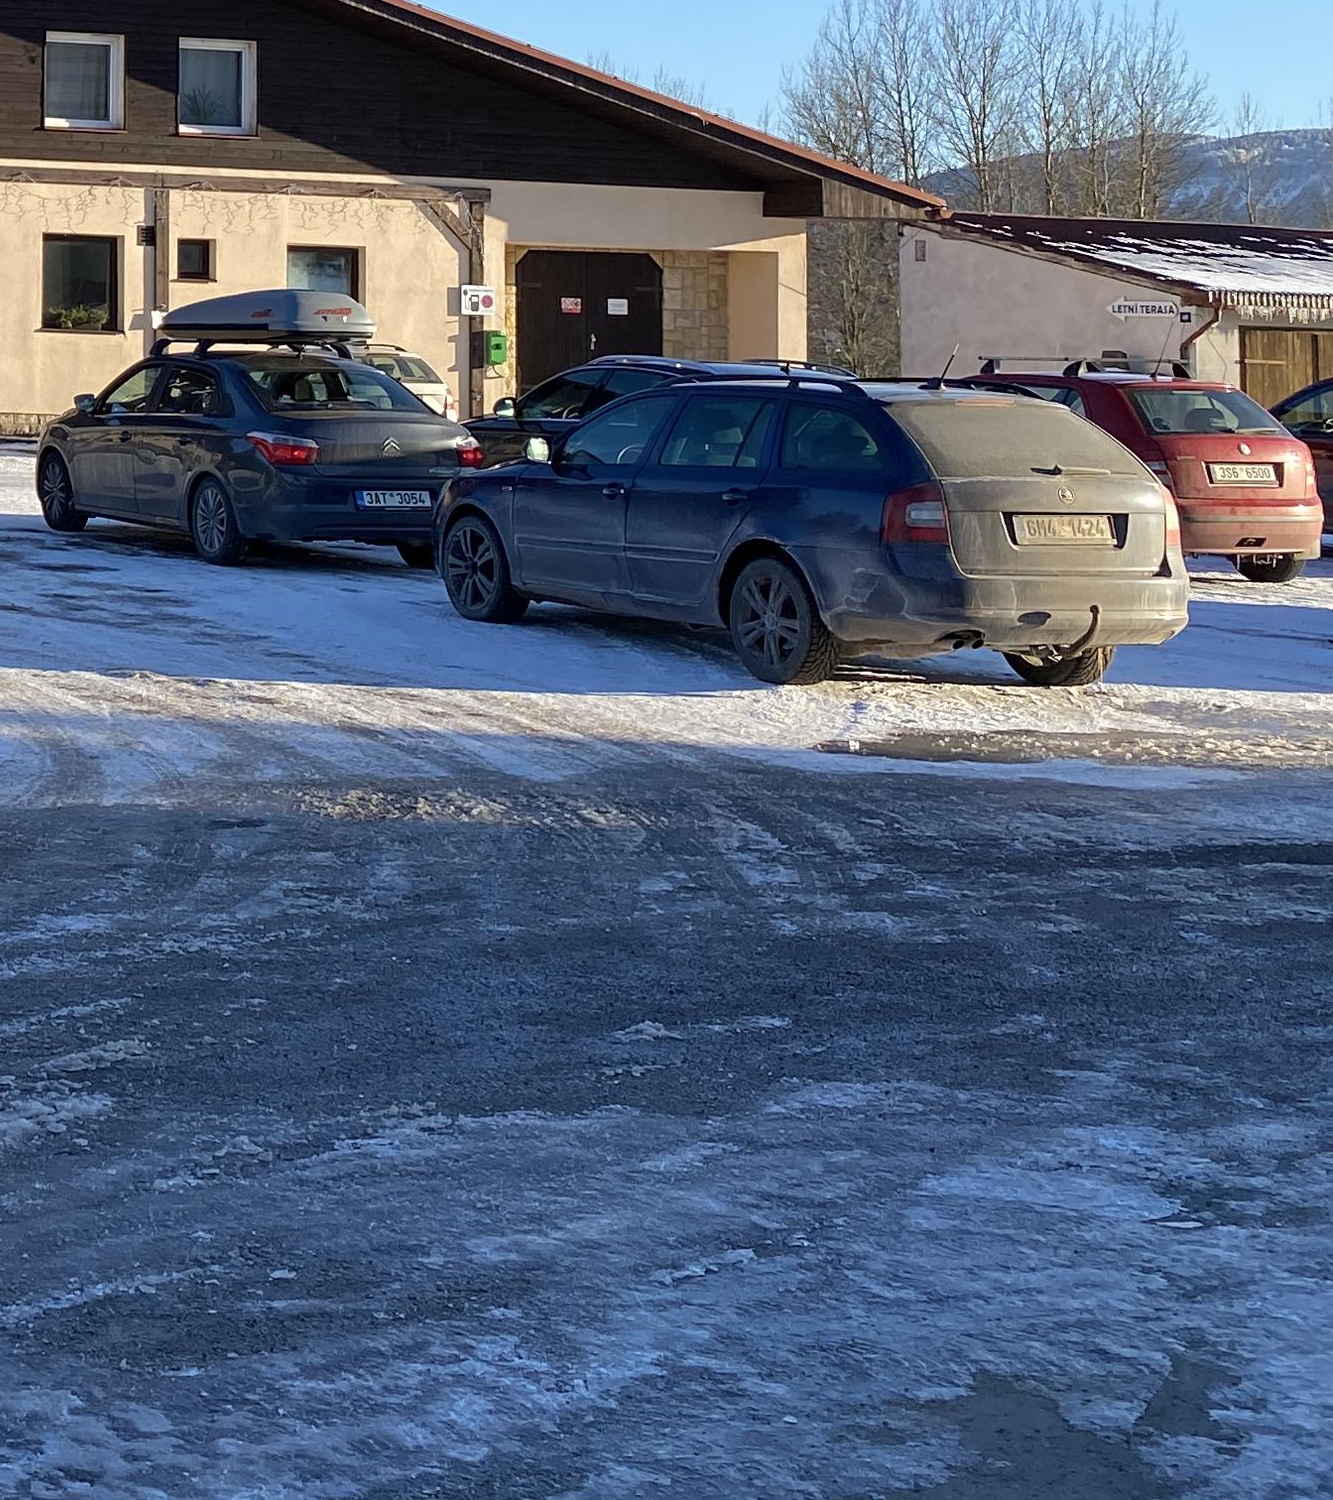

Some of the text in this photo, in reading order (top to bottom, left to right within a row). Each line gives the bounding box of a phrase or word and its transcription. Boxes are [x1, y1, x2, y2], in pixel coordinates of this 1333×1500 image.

[1112, 303, 1175, 314] LETNÍ TERASA
[1219, 466, 1271, 479] 3S6 6500
[366, 492, 426, 505] 3AT 3054
[1070, 519, 1105, 537] 1424
